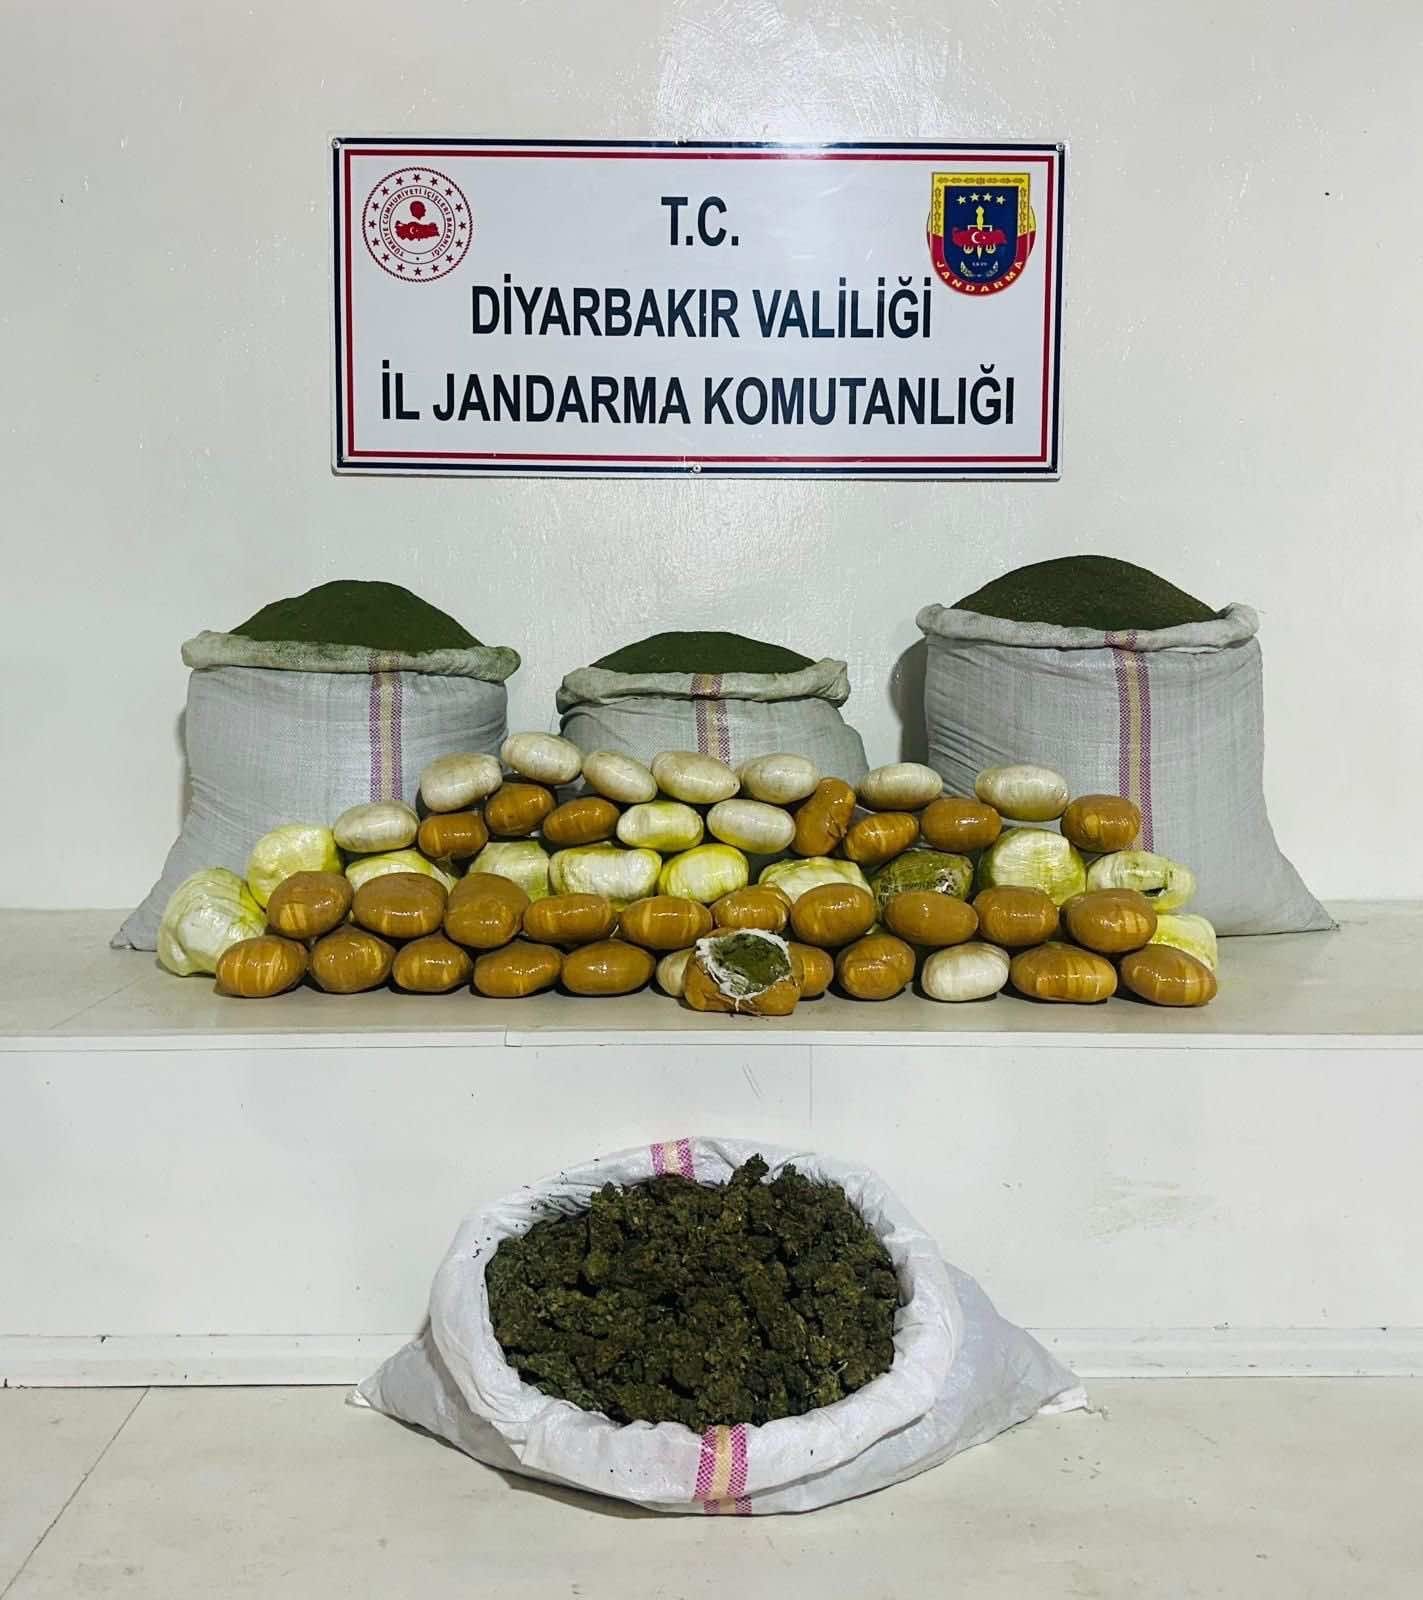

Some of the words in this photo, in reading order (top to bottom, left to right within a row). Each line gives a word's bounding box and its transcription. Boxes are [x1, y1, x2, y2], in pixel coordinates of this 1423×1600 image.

[431, 217, 453, 258] BAKANLIĞI
[660, 196, 739, 247] T.C.
[935, 260, 1024, 293] JANDARMA
[471, 273, 741, 338] DİYARBAKIR
[752, 275, 932, 339] VALİLİĞİ
[381, 359, 421, 421] İL
[432, 373, 692, 425] JANDARMA
[704, 363, 1015, 426] KOMUTANLIĞI
